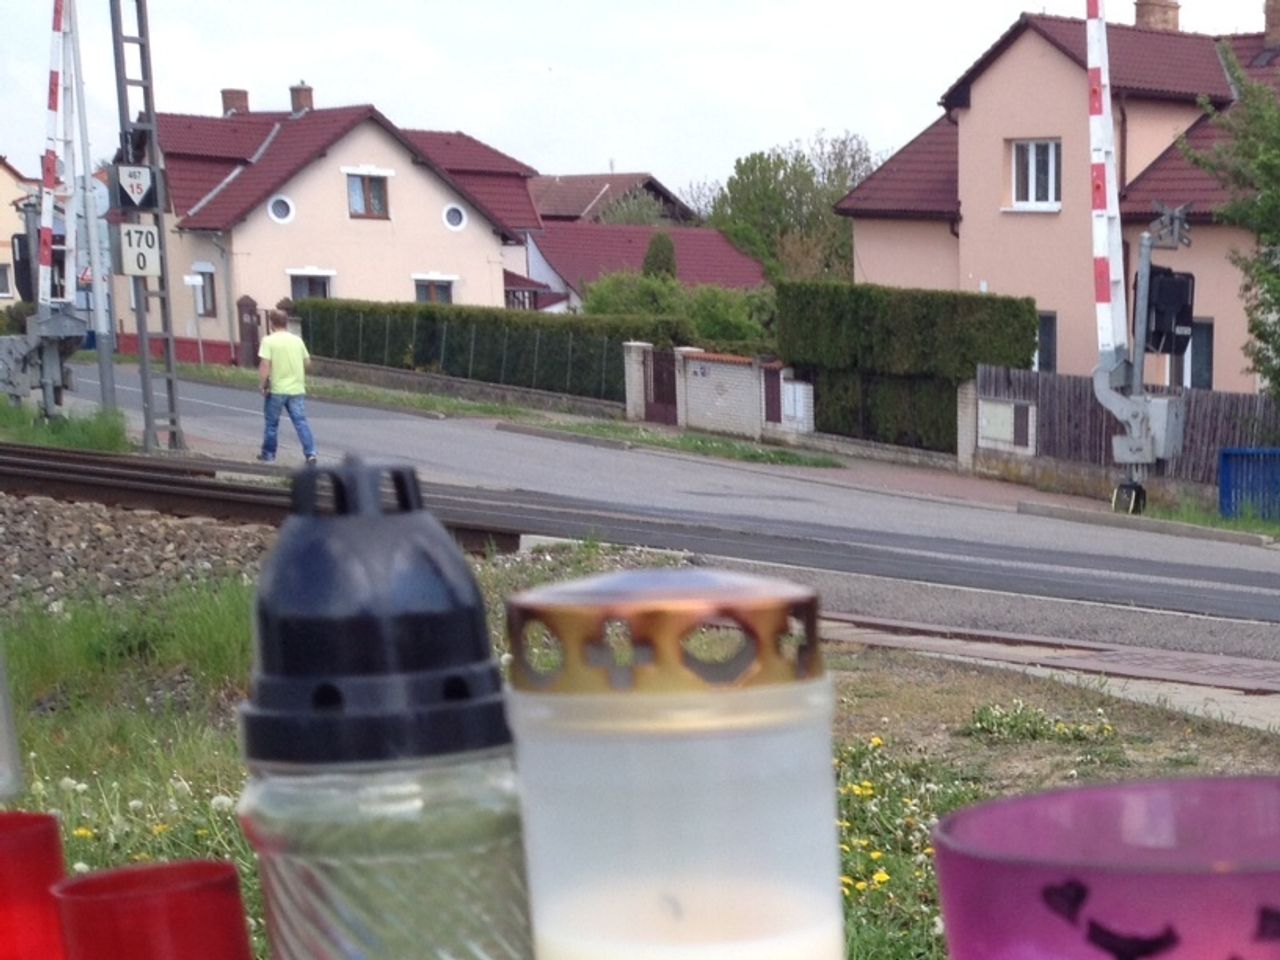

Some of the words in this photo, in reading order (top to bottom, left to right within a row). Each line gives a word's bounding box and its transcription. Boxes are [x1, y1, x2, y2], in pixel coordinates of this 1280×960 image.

[130, 183, 144, 195] 15
[124, 229, 155, 249] 170
[136, 252, 147, 270] 0
